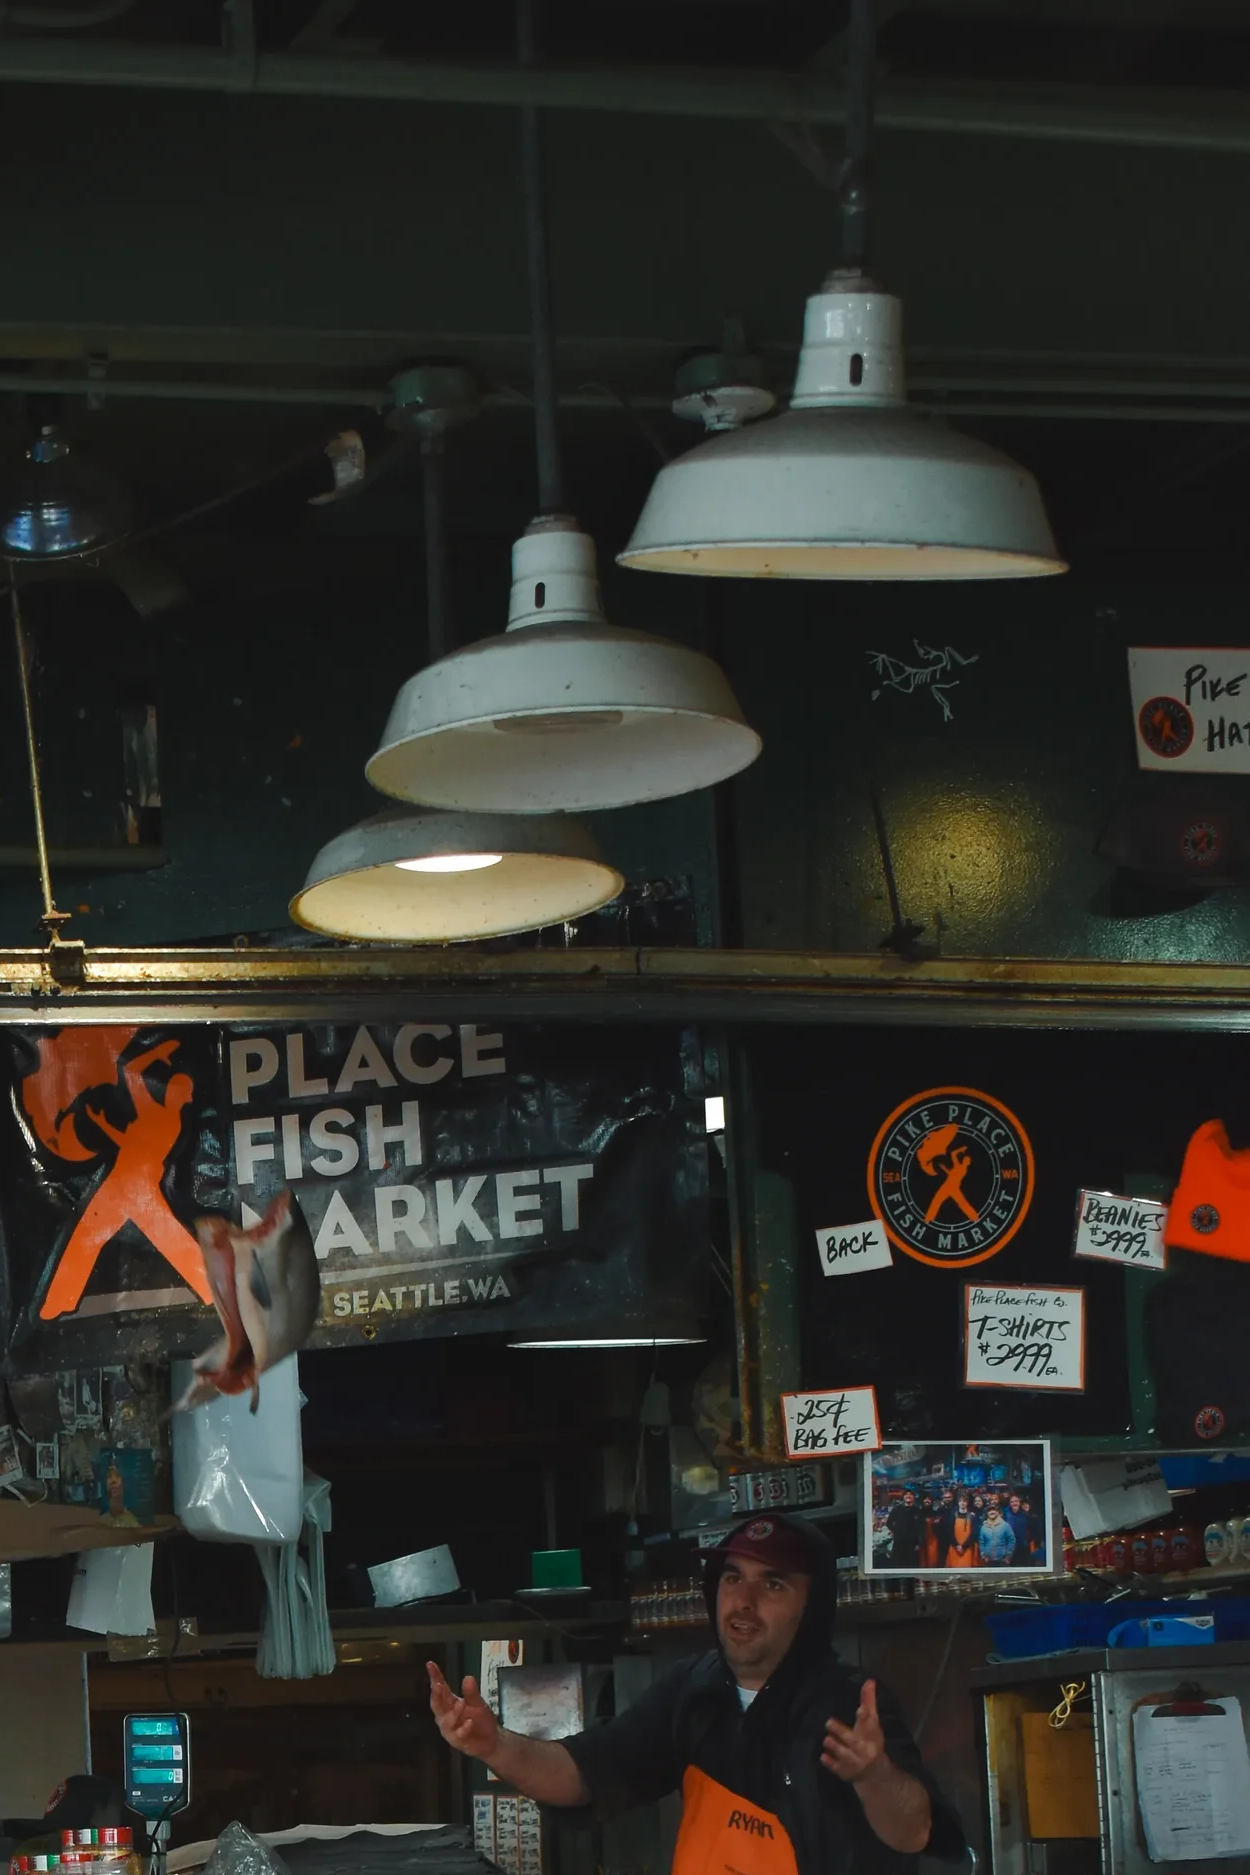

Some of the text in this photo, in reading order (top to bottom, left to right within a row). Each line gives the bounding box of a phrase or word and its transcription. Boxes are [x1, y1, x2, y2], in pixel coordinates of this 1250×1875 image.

[1183, 664, 1248, 706] PIKE
[229, 1024, 507, 1103] PLACE
[235, 1100, 423, 1184] FISH
[887, 1104, 1015, 1162] PIKE PLACE
[883, 1172, 901, 1183] SEA
[1001, 1169, 1019, 1181] WA
[242, 1163, 594, 1260] ARKET
[887, 1190, 1015, 1250] FISH MARKET
[1083, 1198, 1164, 1231] BEANIES
[826, 1231, 878, 1264] BACK
[969, 1313, 1071, 1341] T-SHIRTS
[793, 1428, 827, 1450] BAG
